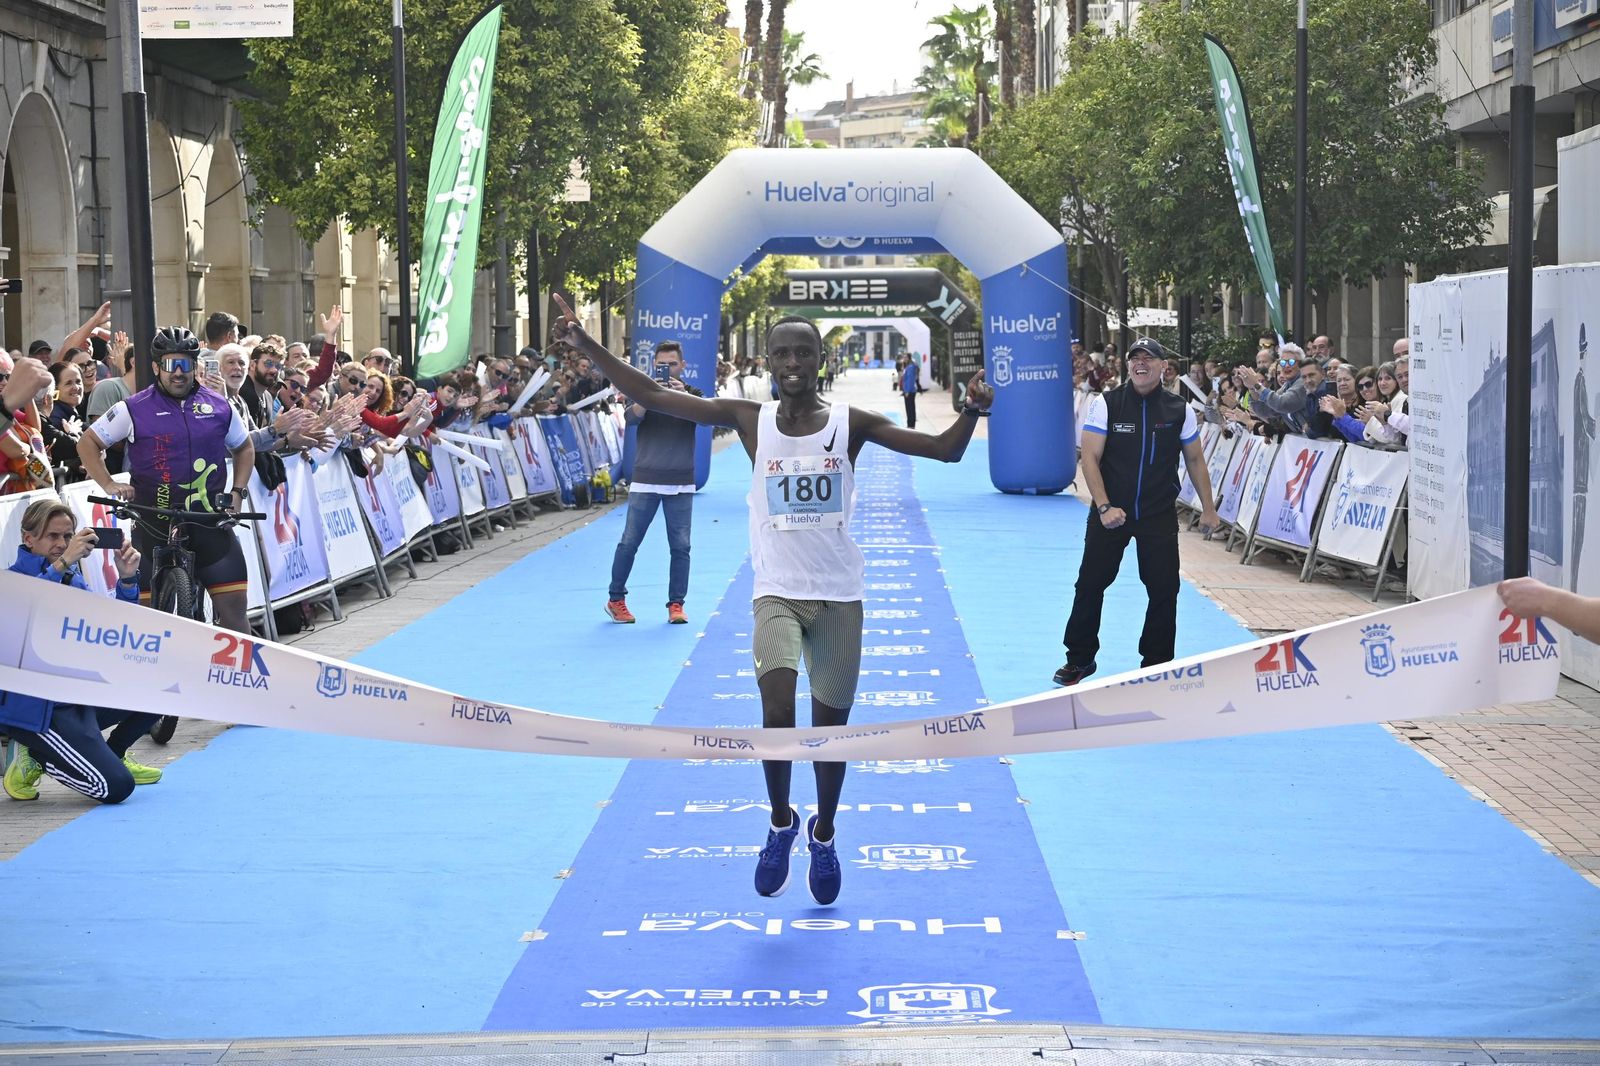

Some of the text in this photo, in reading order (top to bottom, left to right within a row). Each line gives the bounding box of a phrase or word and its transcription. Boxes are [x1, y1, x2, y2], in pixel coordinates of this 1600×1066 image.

[765, 180, 934, 208] Huelva original
[638, 309, 702, 331] Huelva
[990, 313, 1057, 334] Huelva
[1016, 370, 1058, 381] HUELVA
[778, 475, 832, 502] 180
[157, 483, 171, 520] SNRISA
[786, 514, 821, 524] Huelva
[61, 616, 162, 653] Huelva
[1498, 607, 1558, 646] 21K
[124, 653, 159, 664] original
[210, 632, 271, 676] 21K
[1254, 632, 1318, 674] 21K
[1402, 650, 1459, 668] HUELVA
[1498, 644, 1558, 664] HUELVA
[208, 668, 268, 690] HUELVA
[1169, 680, 1205, 692] original
[1256, 672, 1320, 692] HUELVA
[352, 684, 408, 701] HUELVA
[452, 704, 512, 724] HUELVA
[924, 716, 986, 736] HUELVA
[694, 734, 755, 750] HUELVA
[642, 911, 766, 920] original
[638, 917, 1002, 935] Huelva
[585, 989, 828, 1000] HUELVA
